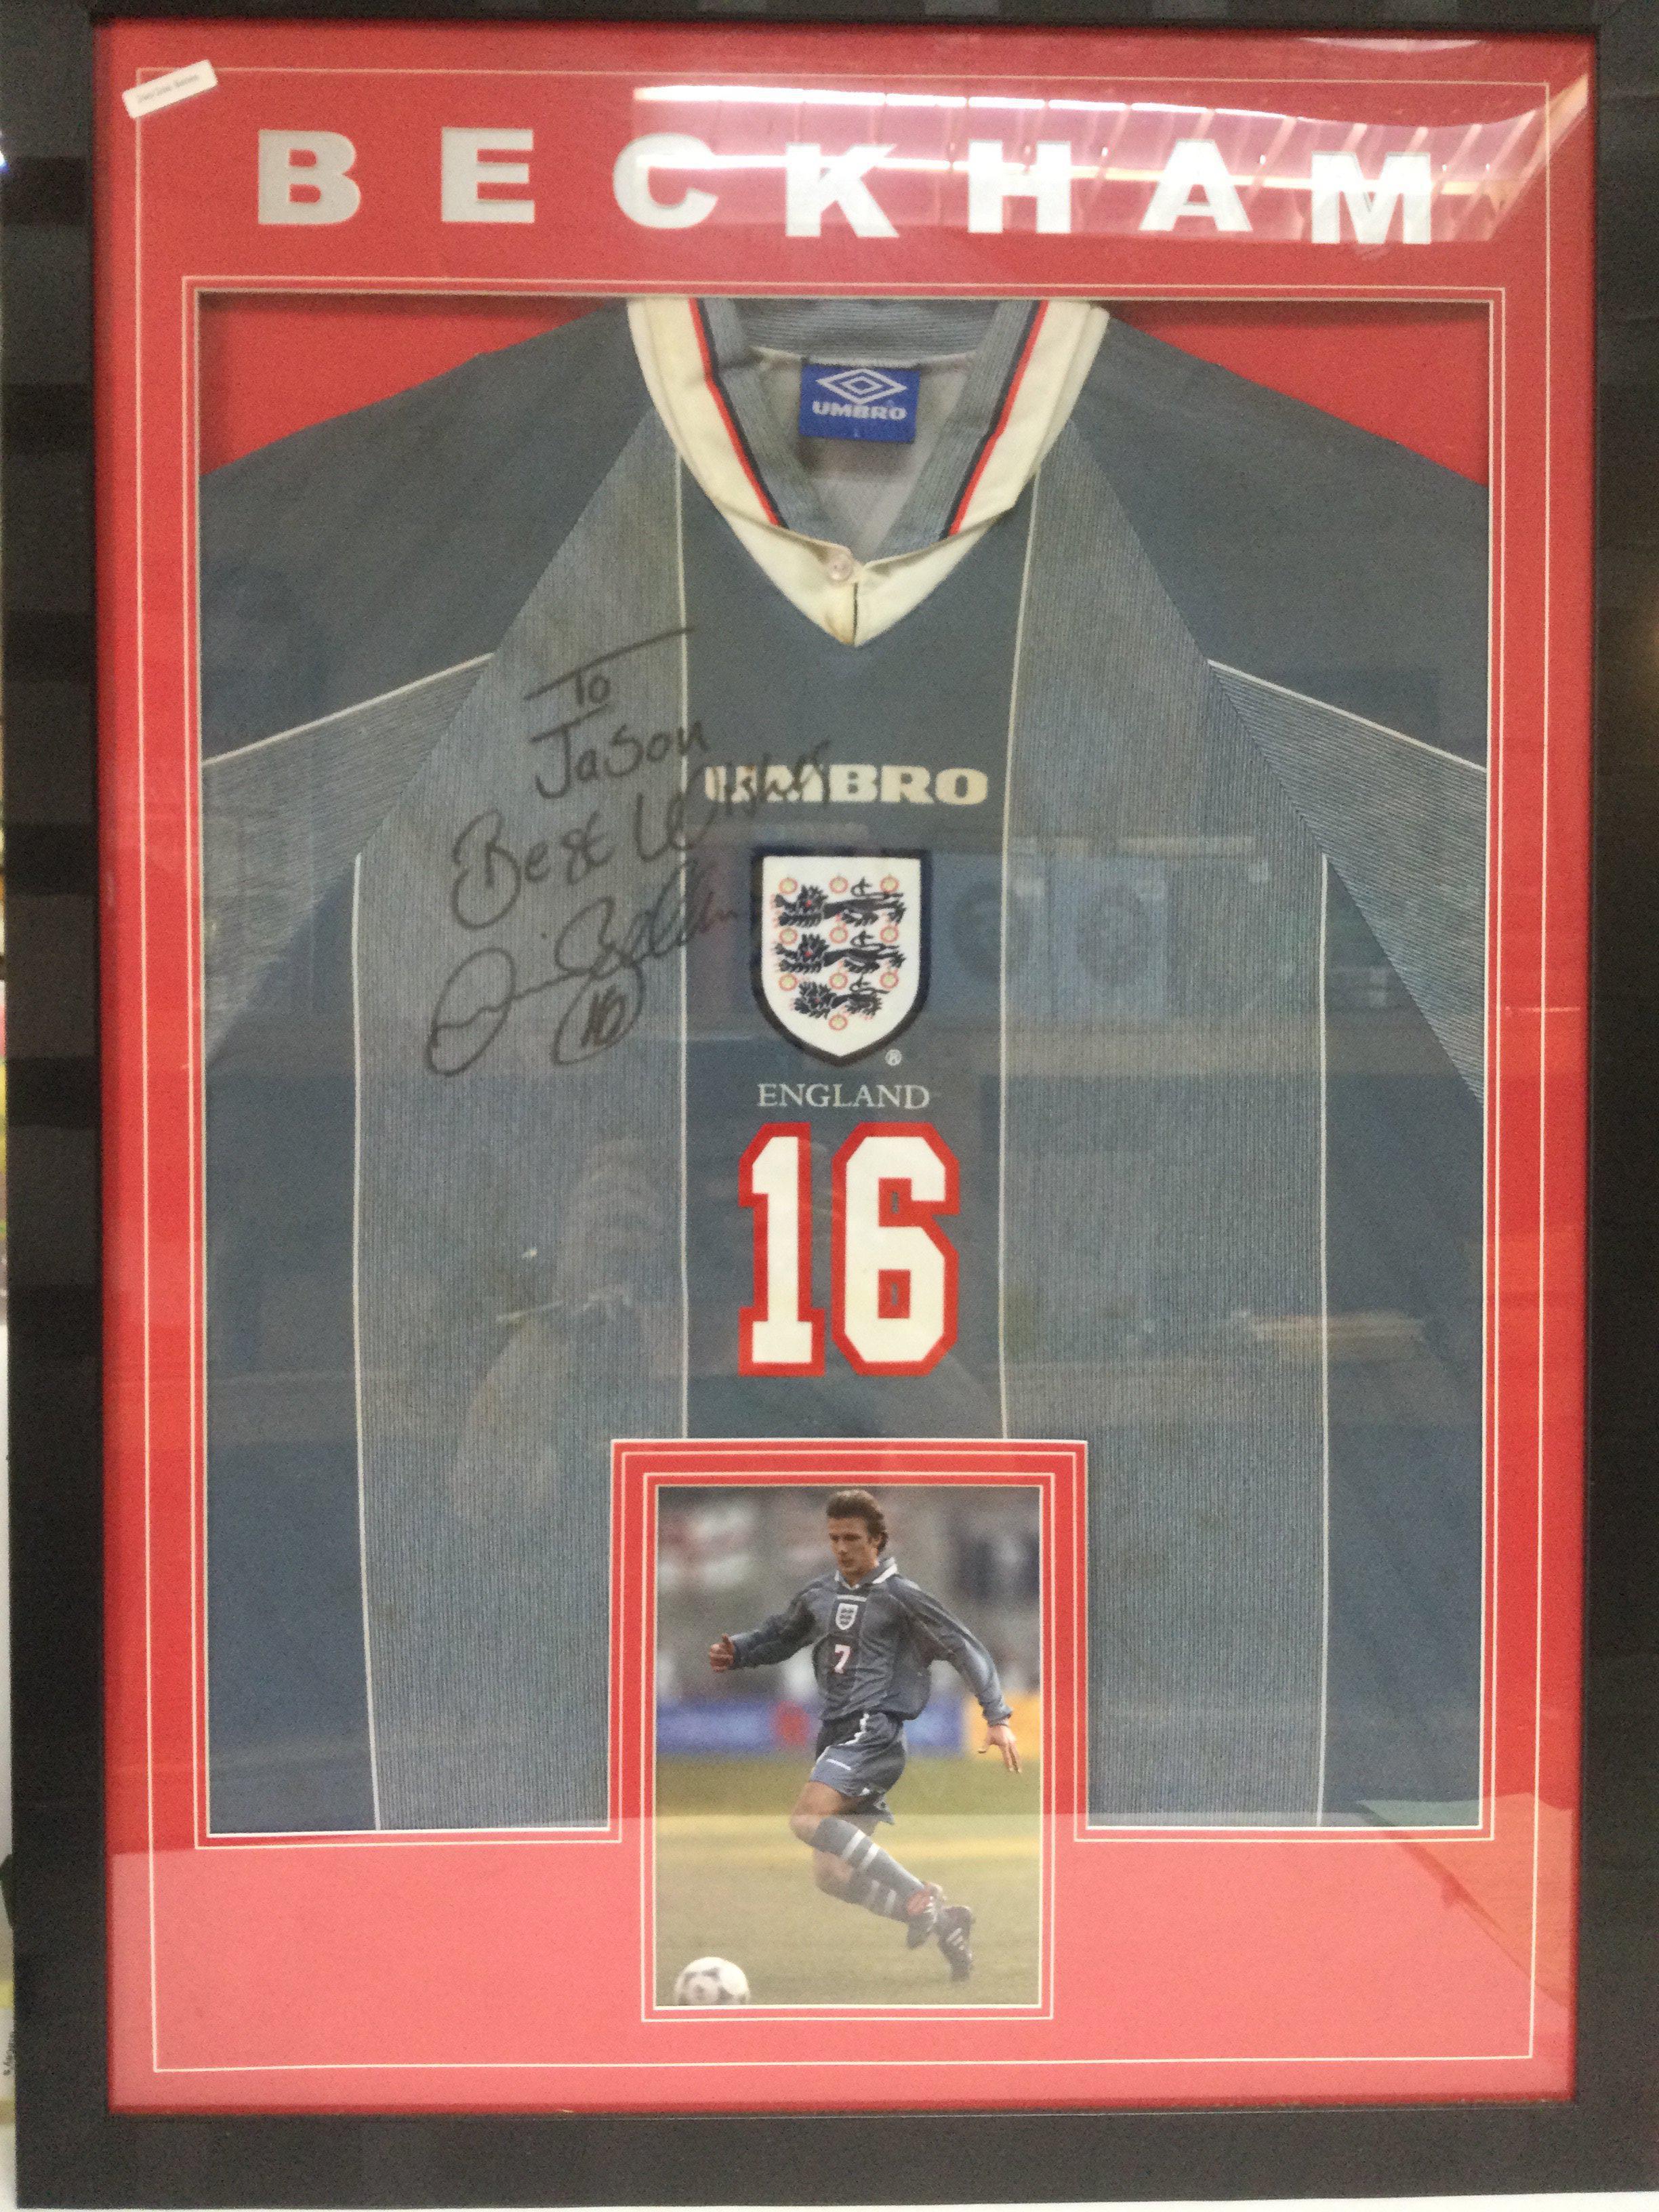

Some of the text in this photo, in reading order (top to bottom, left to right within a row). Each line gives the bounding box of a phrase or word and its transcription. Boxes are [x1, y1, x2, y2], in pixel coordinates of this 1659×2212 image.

[258, 127, 1431, 245] BECKHAM
[813, 401, 907, 420] UMBRO
[523, 628, 695, 705] To
[705, 764, 987, 805] UMBRO
[757, 1084, 930, 1109] ENGLAND
[739, 1122, 960, 1376] 16
[834, 1643, 851, 1674] 7
